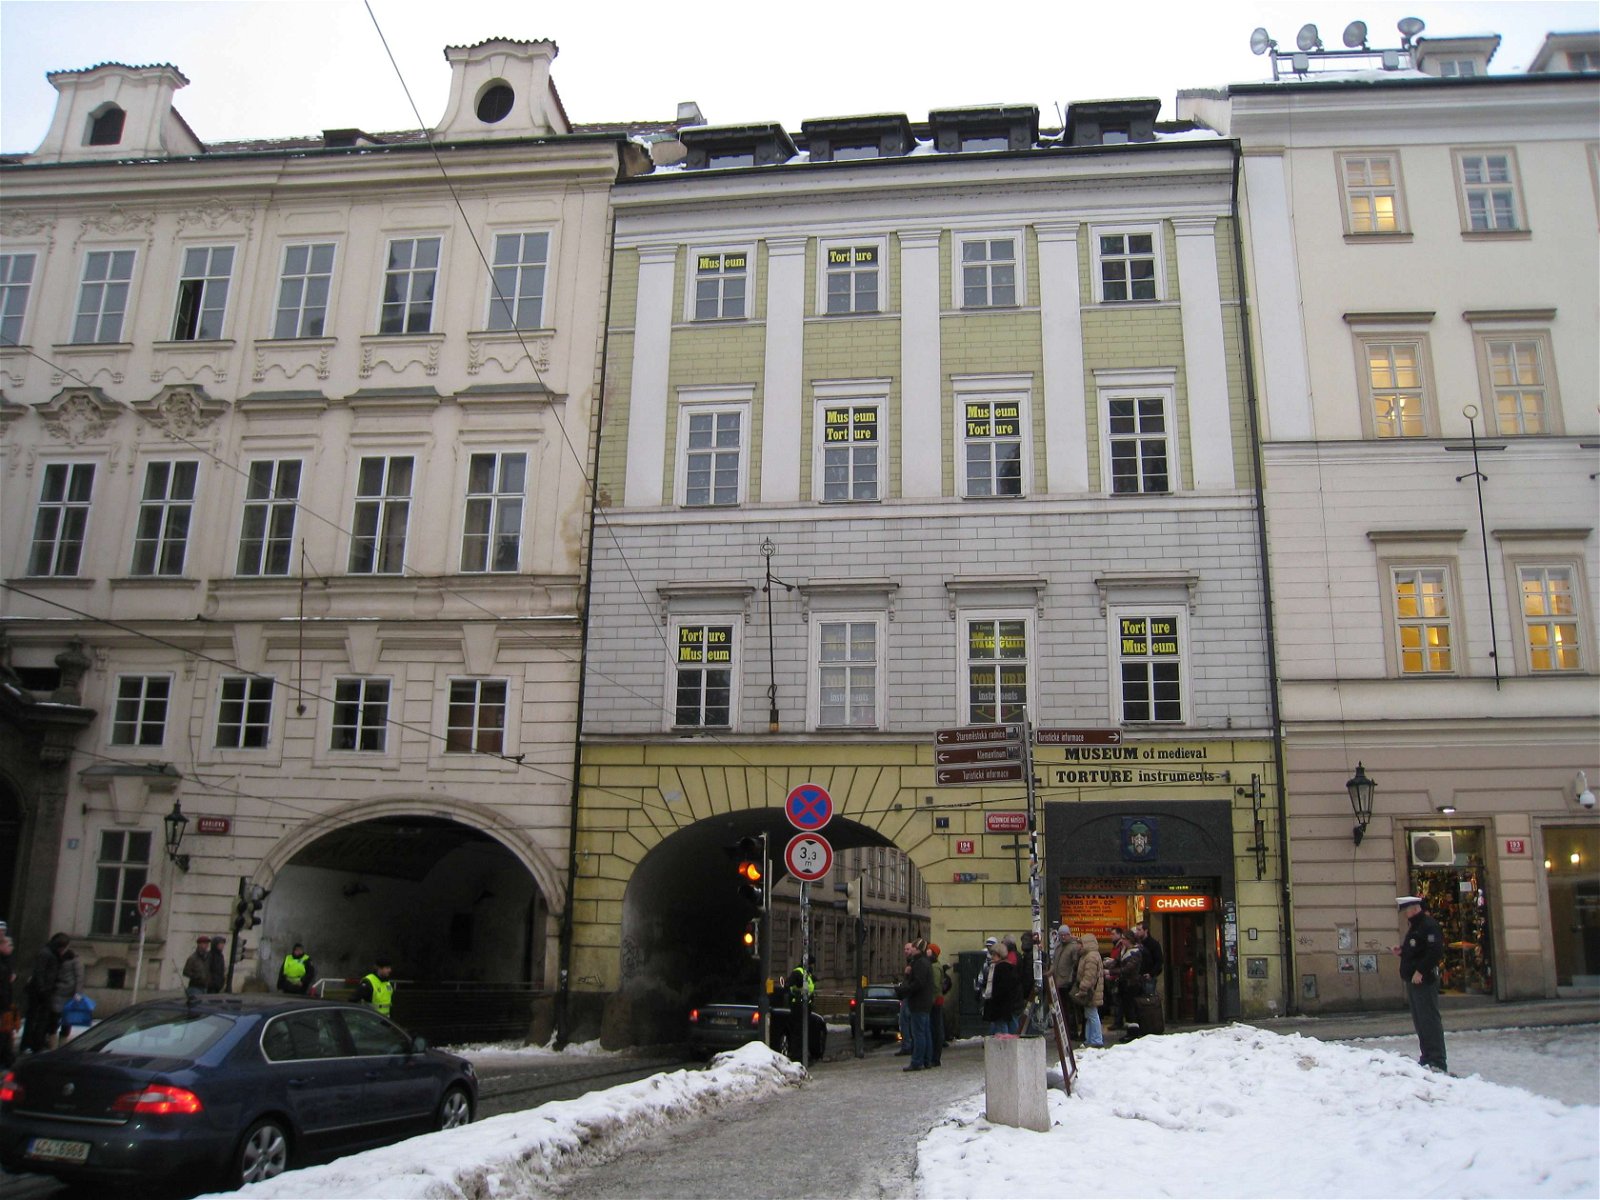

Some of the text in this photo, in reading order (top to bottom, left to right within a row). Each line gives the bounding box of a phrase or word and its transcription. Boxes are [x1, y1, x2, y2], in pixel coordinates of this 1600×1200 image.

[699, 257, 745, 269] Museum
[829, 250, 872, 263] Torture
[826, 410, 876, 424] Museum
[966, 405, 1018, 419] Museum
[826, 427, 872, 441] Torture
[967, 422, 1013, 436] Torture
[1122, 620, 1170, 634] Torture
[681, 629, 726, 642] Torture
[1122, 639, 1176, 653] Museum
[680, 647, 730, 661] Museum
[1065, 747, 1207, 761] MUSEUM of medieval
[1056, 769, 1133, 783] TORTURE
[960, 841, 971, 849] 194
[1156, 898, 1205, 909] CHANGE
